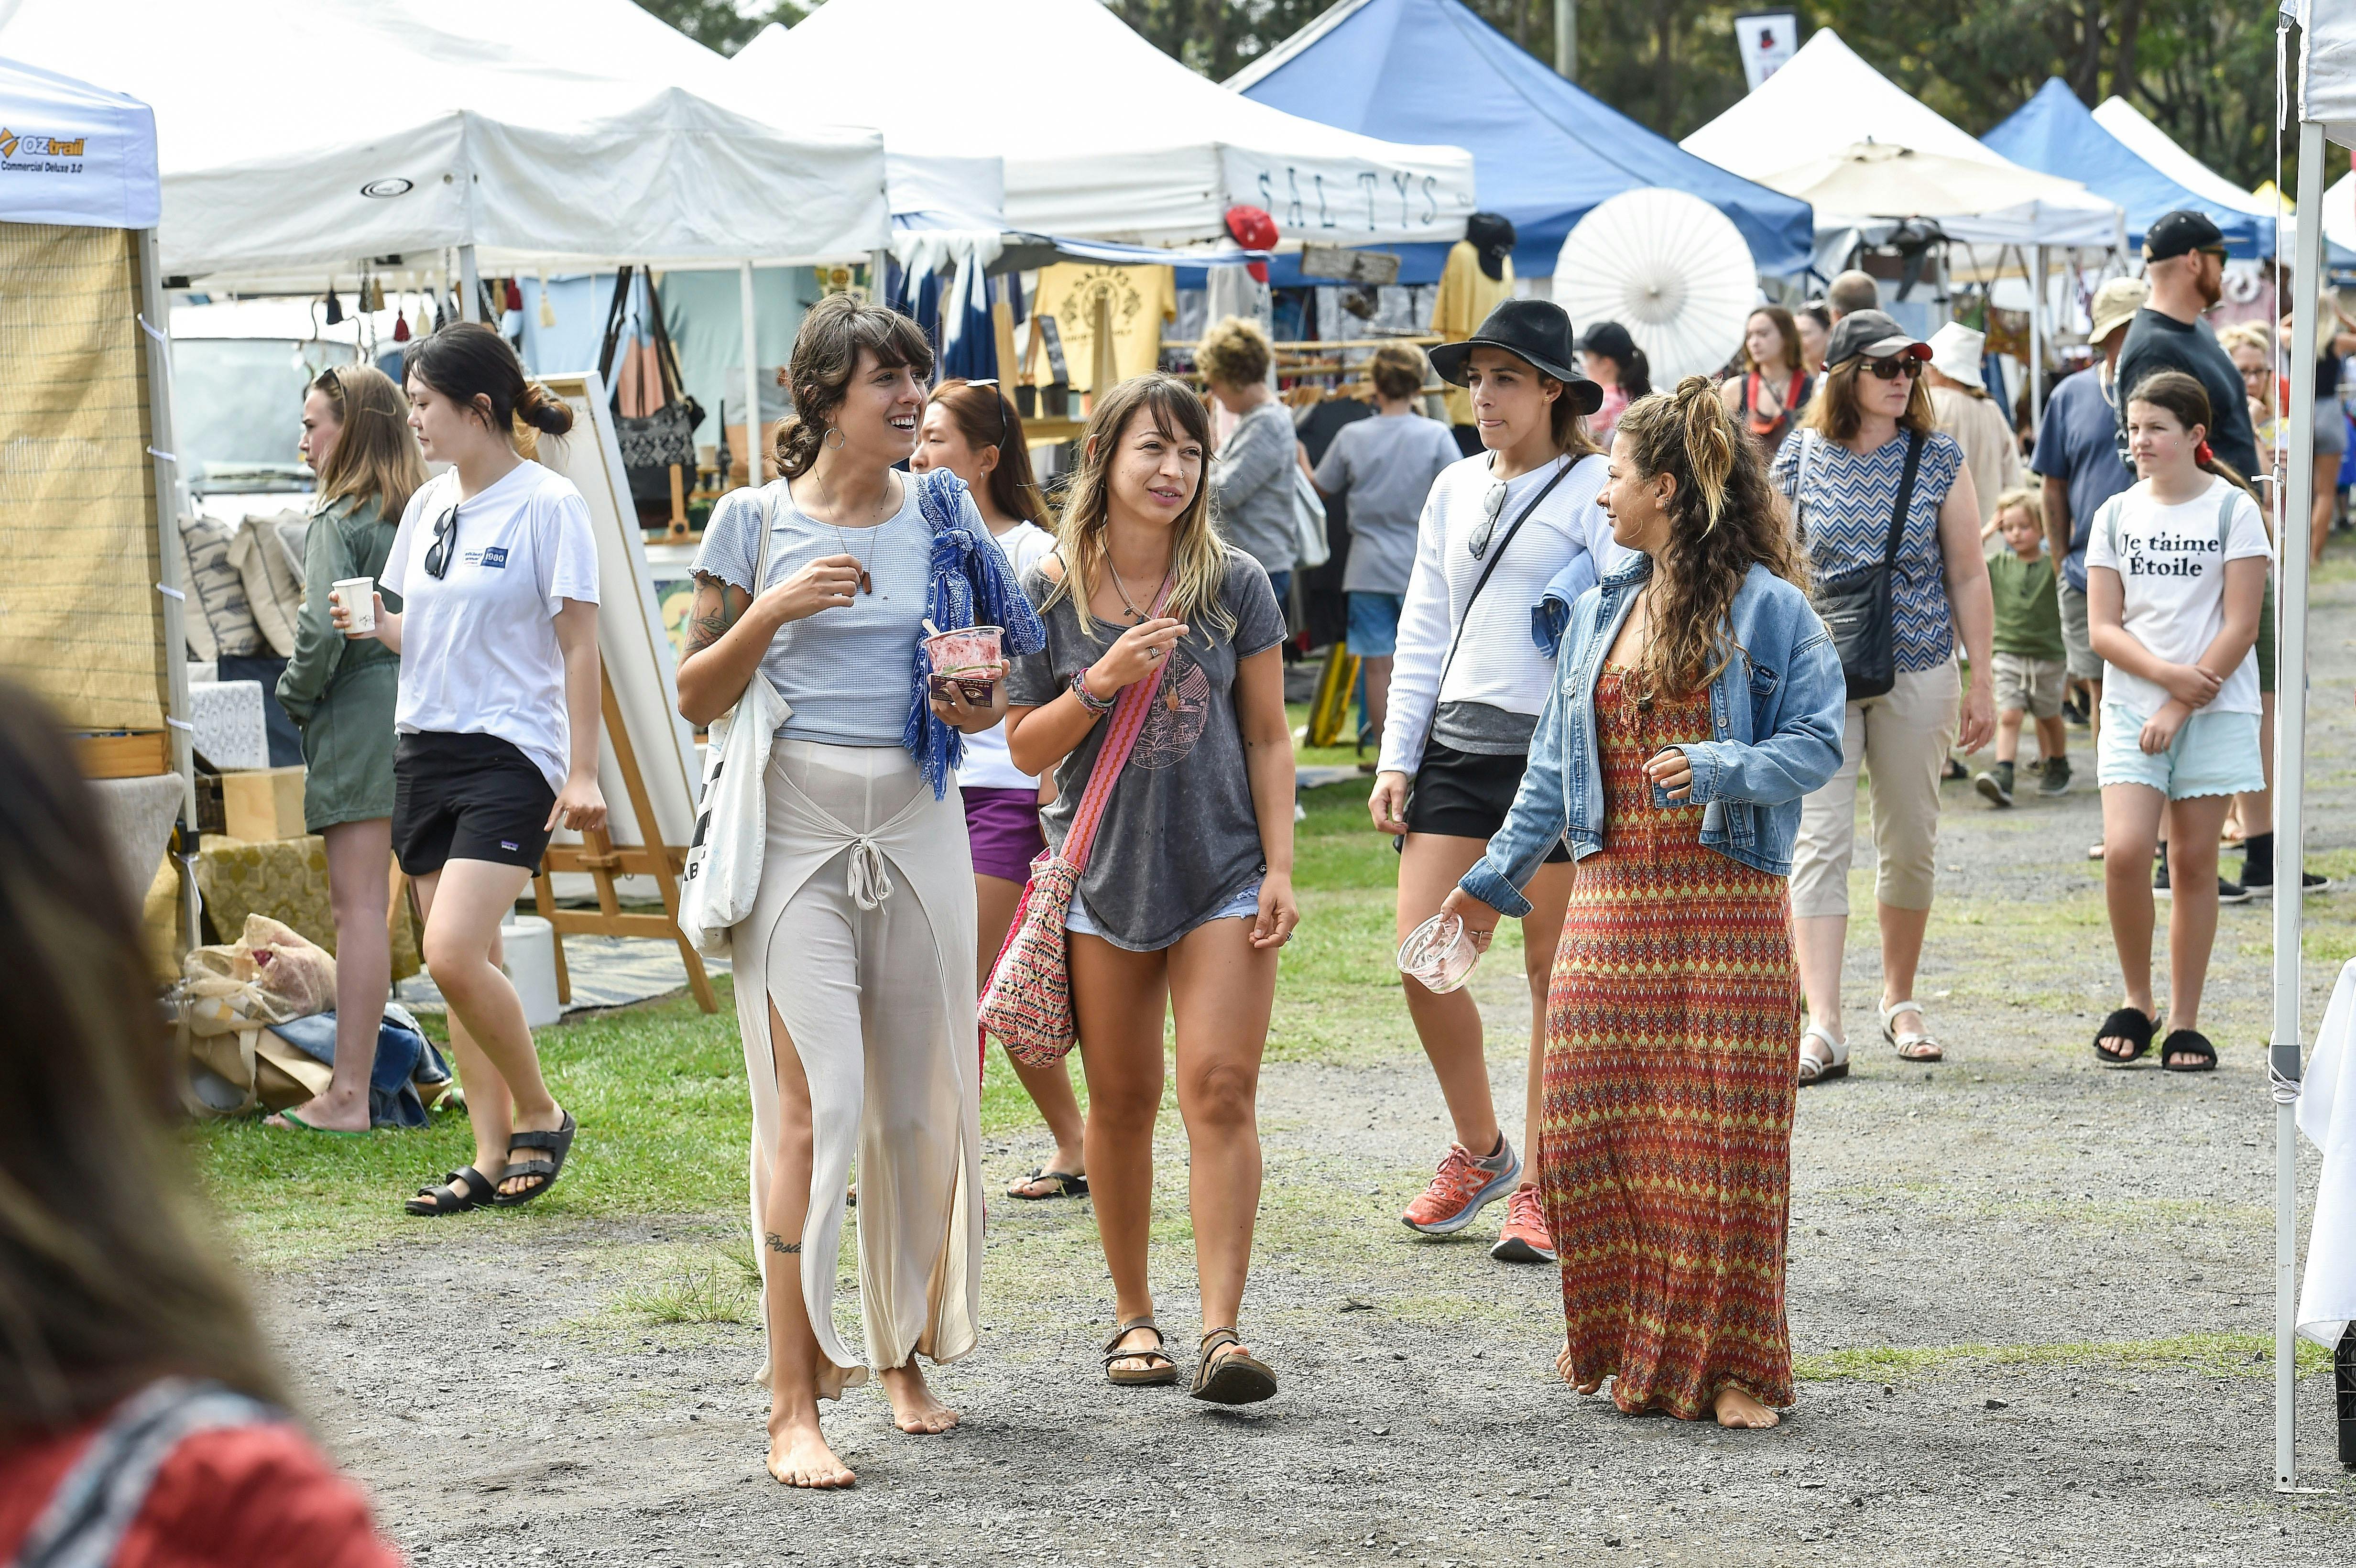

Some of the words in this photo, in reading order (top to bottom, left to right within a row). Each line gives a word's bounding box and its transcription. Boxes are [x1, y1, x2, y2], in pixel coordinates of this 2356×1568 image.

[22, 135, 84, 156] OZtrail
[1, 161, 43, 172] Commercial
[45, 163, 68, 173] Deluxe
[71, 163, 83, 173] 3.0
[2121, 533, 2141, 557] Je
[485, 552, 504, 562] 1980
[2129, 550, 2203, 577] Étoile
